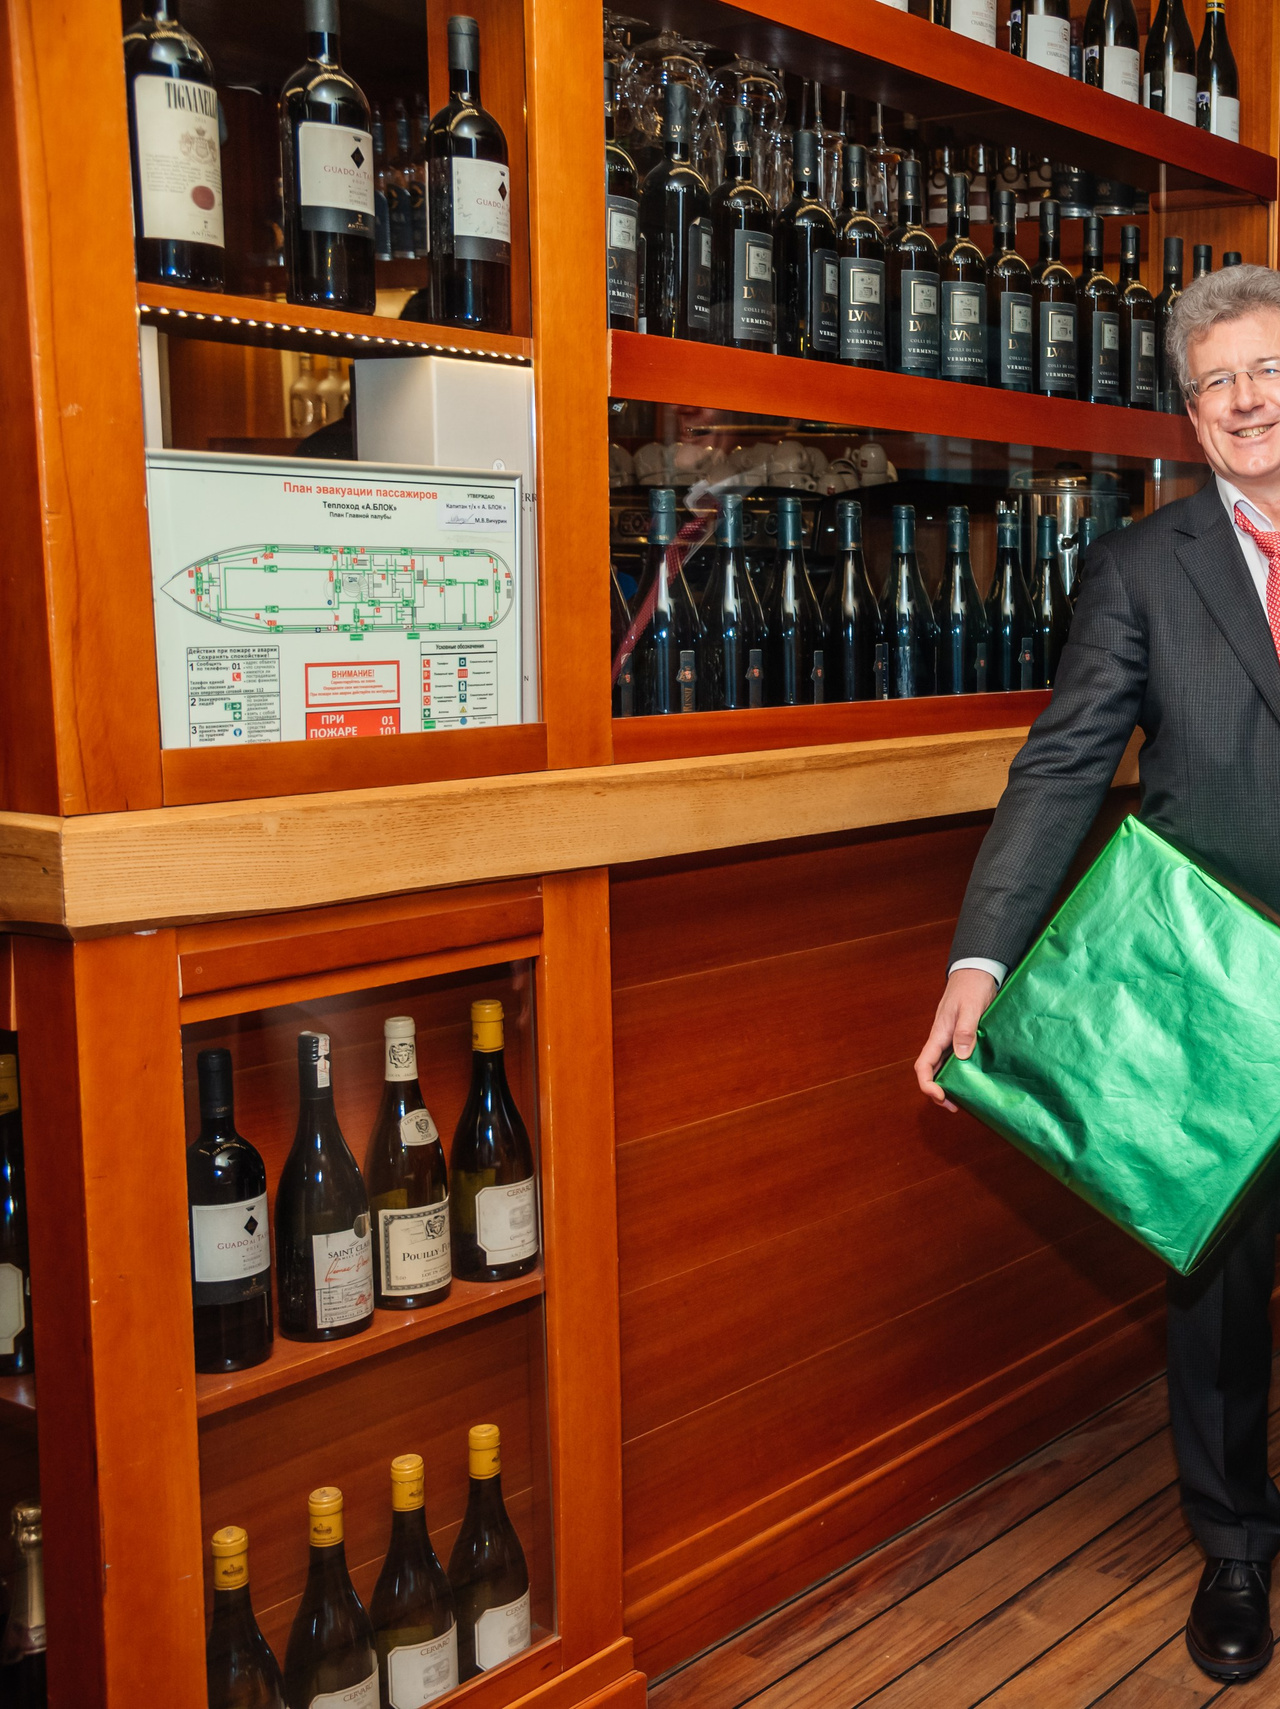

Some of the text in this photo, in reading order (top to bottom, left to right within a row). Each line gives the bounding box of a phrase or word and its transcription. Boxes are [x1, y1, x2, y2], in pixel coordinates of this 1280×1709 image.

[324, 165, 355, 176] GUADO
[476, 198, 501, 208] GUADO
[283, 481, 438, 500] План эвакуации пассажиров
[323, 501, 397, 511] Теплоход «А.БЛОК»
[189, 663, 194, 671] 1
[232, 662, 241, 670] 01
[331, 669, 375, 678] ВНИМАНИЕ!
[191, 698, 196, 706] 2
[321, 714, 344, 724] ПРИ
[381, 716, 394, 725] 01
[192, 726, 197, 735] 3
[310, 726, 358, 738] ПОЖАРЕ
[380, 727, 396, 735] 101
[217, 1240, 249, 1250] GUADO
[328, 1246, 354, 1259] SAINT
[420, 1637, 450, 1656] CERVARO
[343, 1682, 373, 1702] CERVARO
